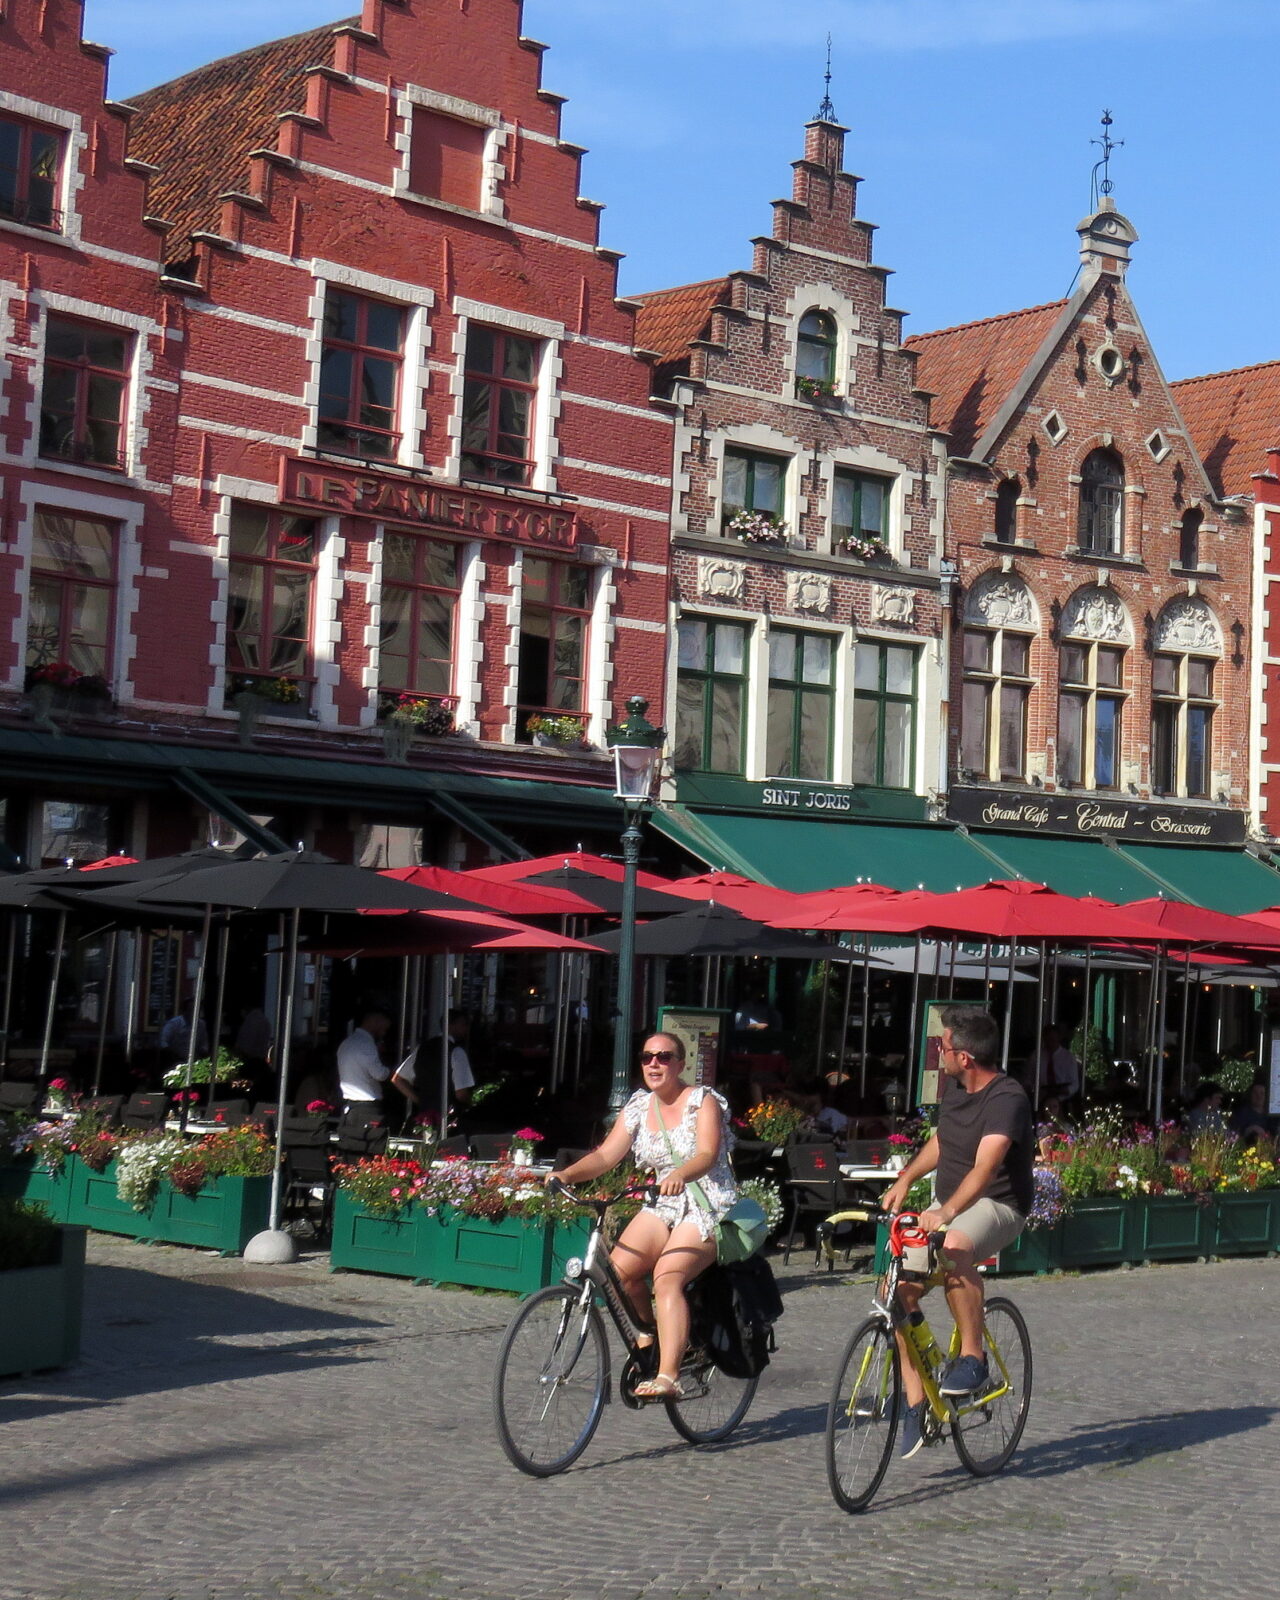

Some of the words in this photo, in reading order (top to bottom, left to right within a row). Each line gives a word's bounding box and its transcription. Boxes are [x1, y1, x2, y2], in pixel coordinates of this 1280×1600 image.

[297, 472, 344, 503] LE
[353, 477, 484, 531] PANIER
[495, 507, 568, 544] D'OR
[762, 788, 800, 807] SINT
[805, 792, 851, 811] JORIS
[982, 802, 1020, 824] Grand
[1022, 804, 1049, 828] Cafe
[1076, 802, 1129, 831] Central
[1150, 815, 1211, 836] Brasserie
